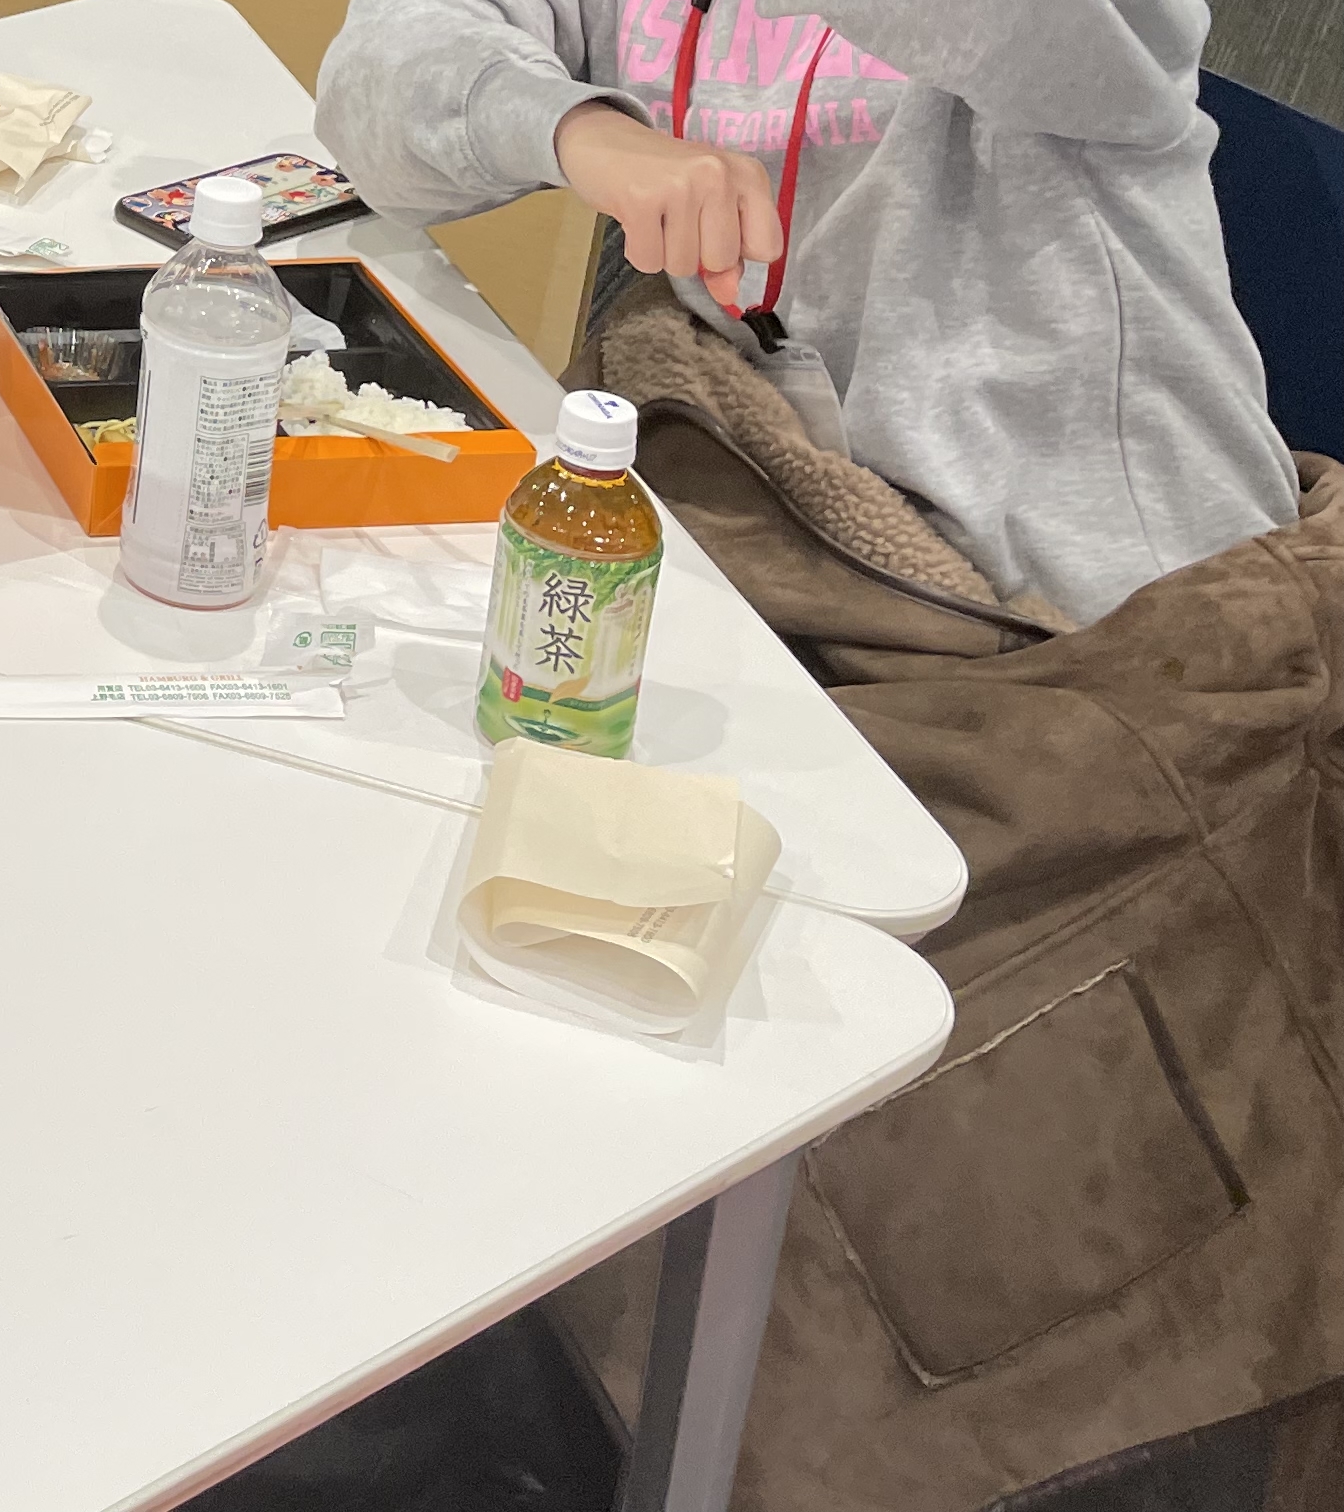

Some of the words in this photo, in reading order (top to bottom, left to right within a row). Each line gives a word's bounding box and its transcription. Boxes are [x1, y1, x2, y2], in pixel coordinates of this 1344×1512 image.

[534, 572, 595, 675] 緑茶
[139, 675, 197, 683] HAMBURG
[210, 674, 244, 682] GRILL
